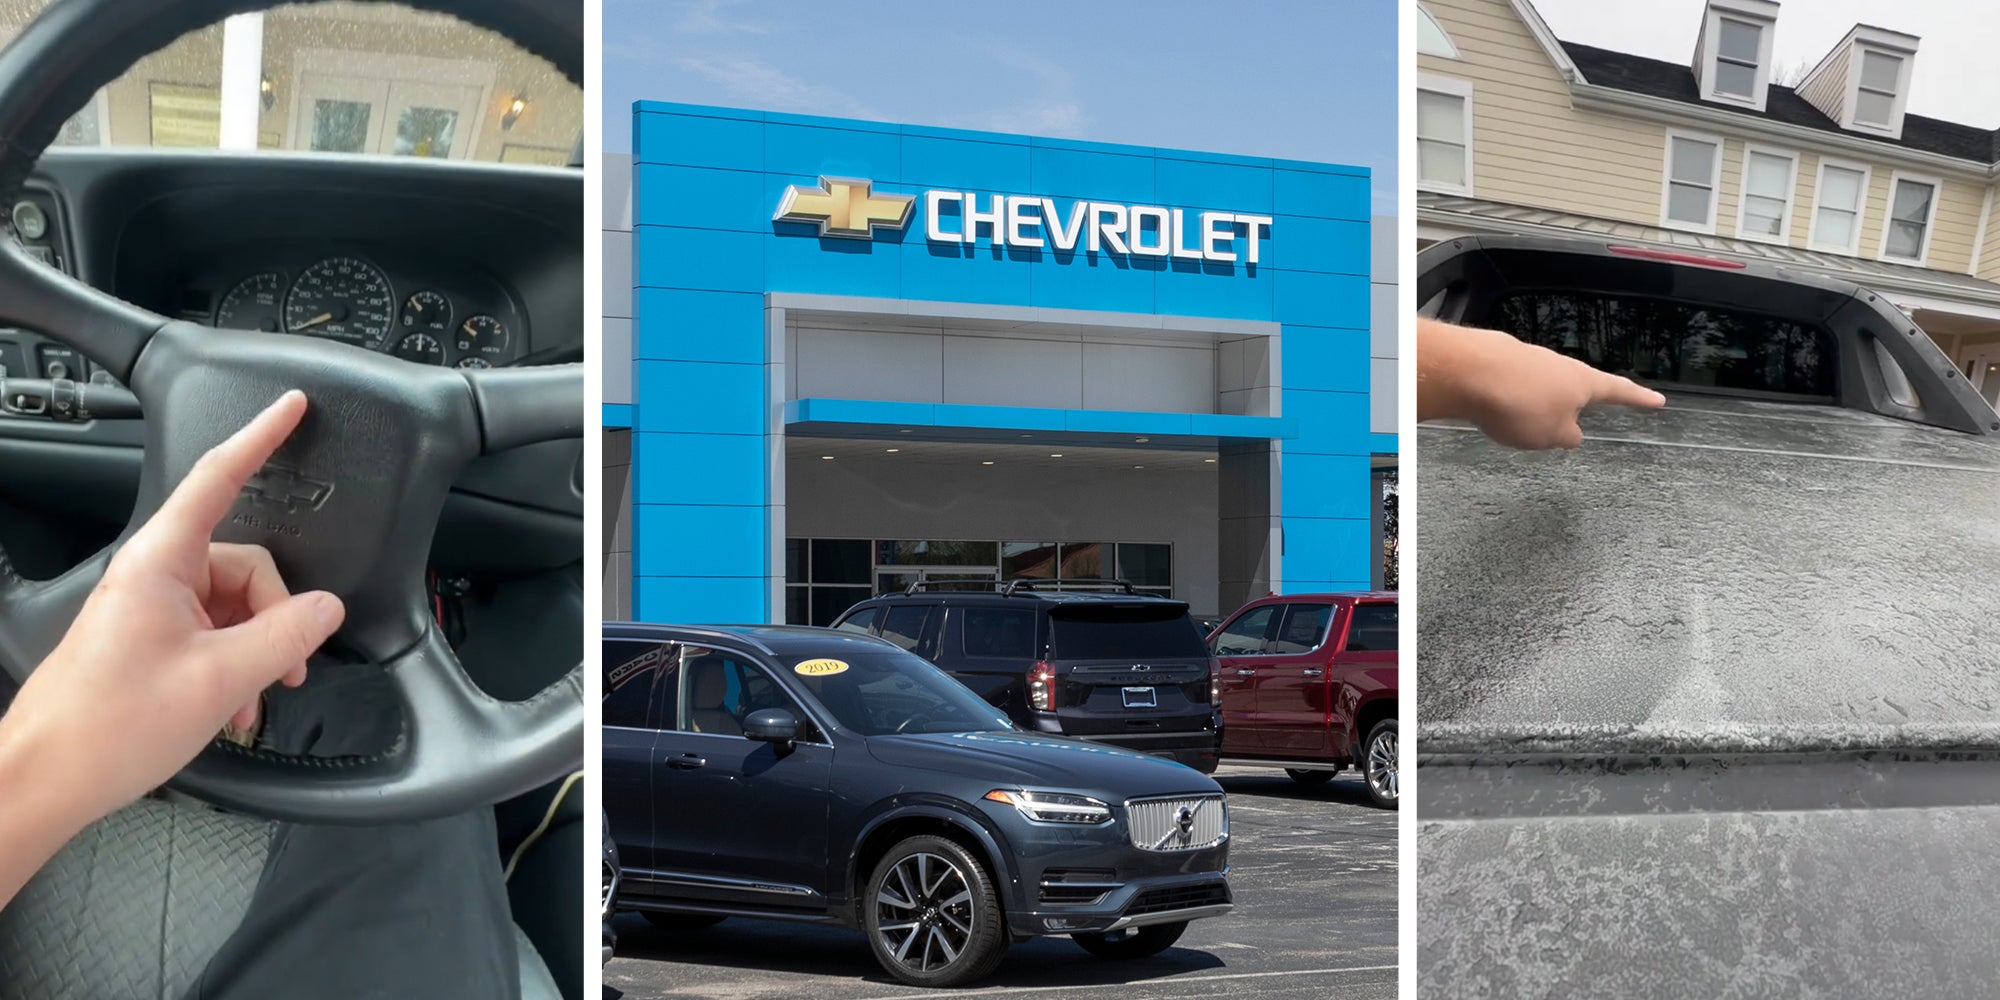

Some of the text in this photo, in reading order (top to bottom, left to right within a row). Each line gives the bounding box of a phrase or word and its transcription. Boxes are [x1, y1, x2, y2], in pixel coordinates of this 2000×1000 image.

[926, 190, 1273, 263] CHEVROLET
[366, 284, 377, 292] 70
[370, 298, 382, 306] 80
[327, 324, 345, 332] MPH
[366, 328, 380, 336] 100
[805, 661, 839, 674] 2019
